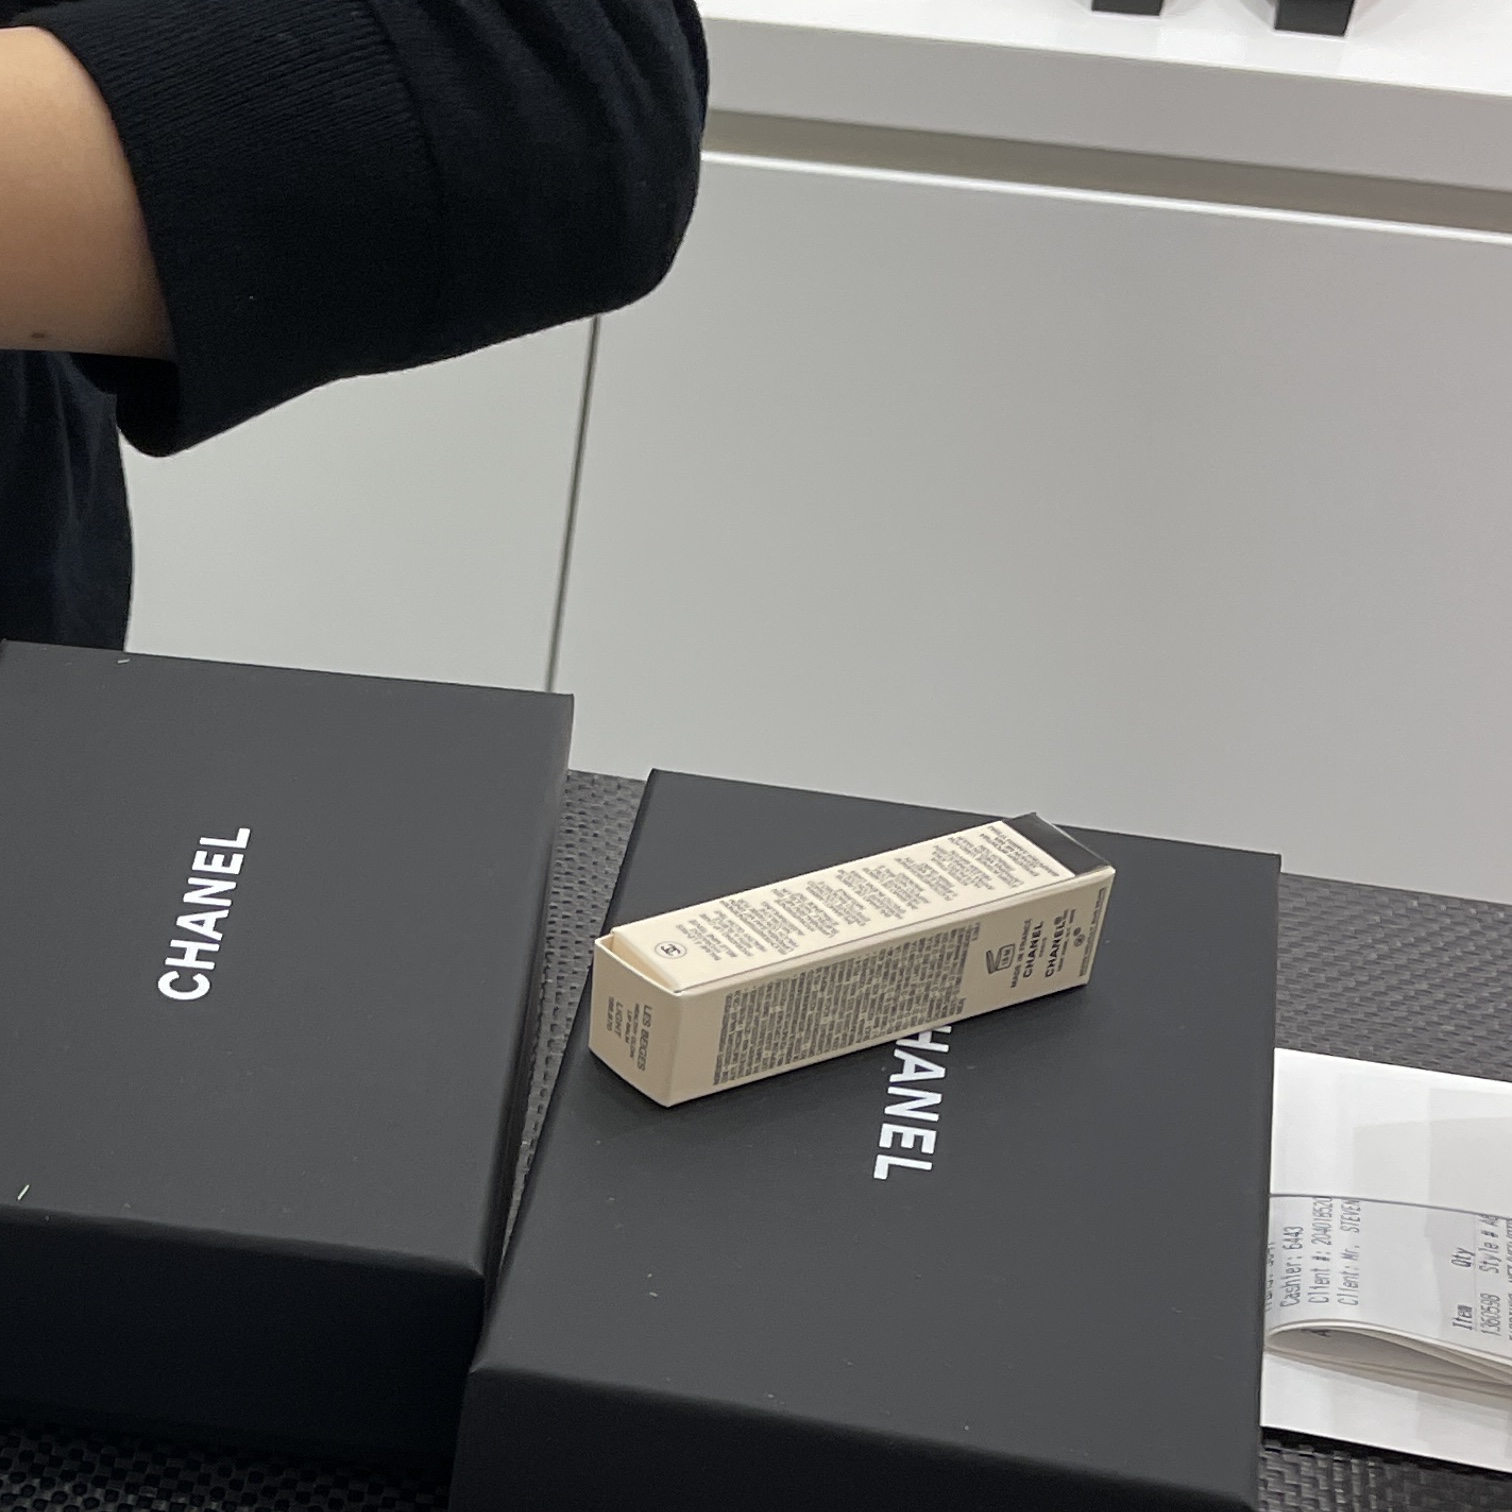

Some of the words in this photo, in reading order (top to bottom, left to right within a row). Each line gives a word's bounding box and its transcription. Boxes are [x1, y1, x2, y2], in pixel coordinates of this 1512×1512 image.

[157, 827, 251, 1001] CHANEL
[1023, 921, 1044, 977] CHANEL
[642, 1004, 653, 1028] LES
[637, 1028, 649, 1071] BEIGES
[873, 1025, 952, 1180] HANEL
[1450, 1246, 1476, 1267] Qty
[1478, 1242, 1502, 1274] Style
[1279, 1256, 1303, 1308] Cashier:
[1307, 1268, 1331, 1304] Client
[1336, 1265, 1360, 1306] Client:
